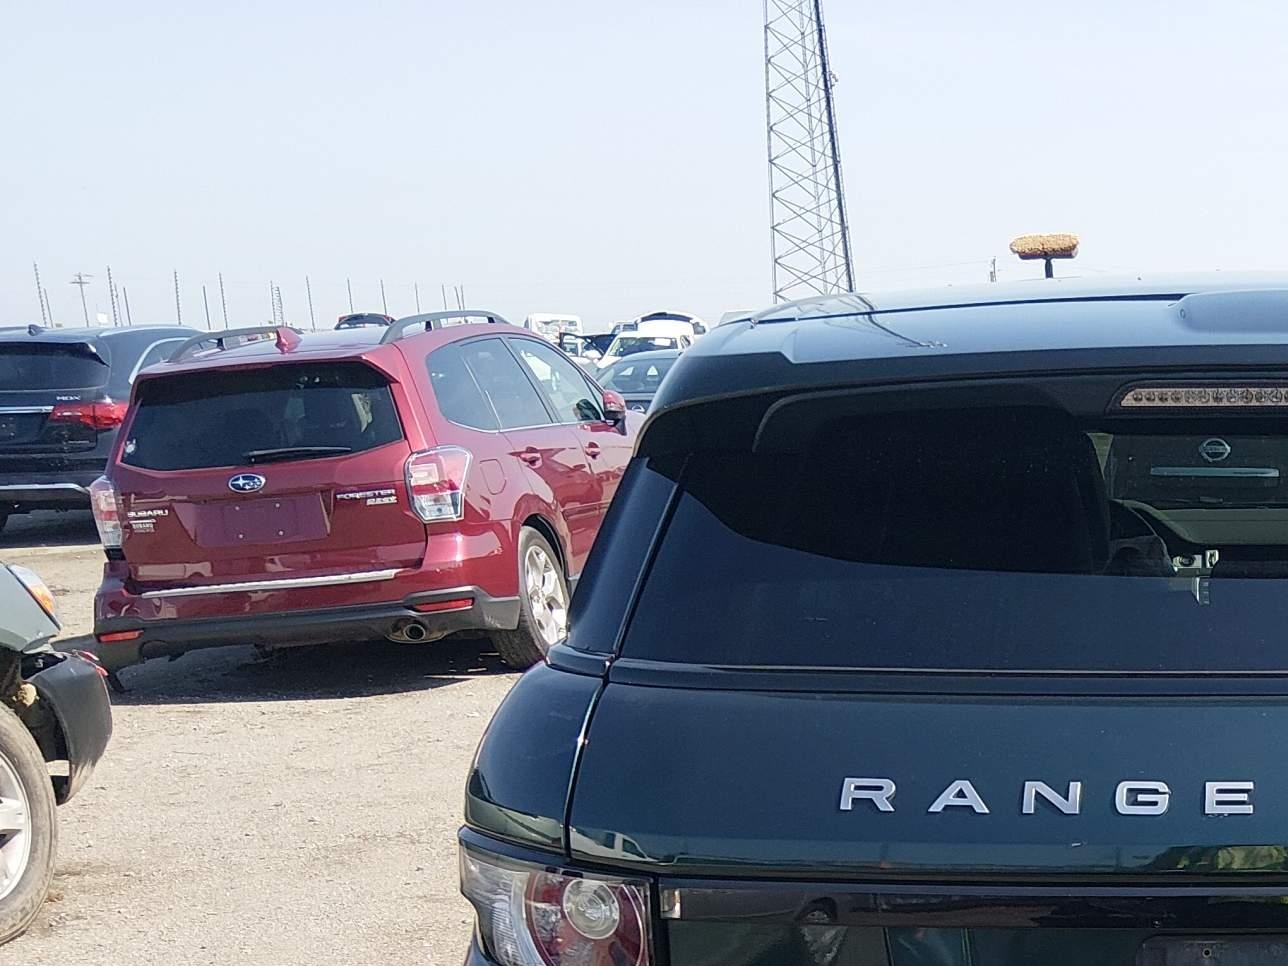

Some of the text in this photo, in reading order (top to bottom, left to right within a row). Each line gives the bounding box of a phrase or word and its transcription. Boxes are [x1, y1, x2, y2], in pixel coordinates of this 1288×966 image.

[336, 489, 396, 499] FORESTER
[127, 509, 169, 517] SUBARU
[839, 777, 1255, 816] RANGE
